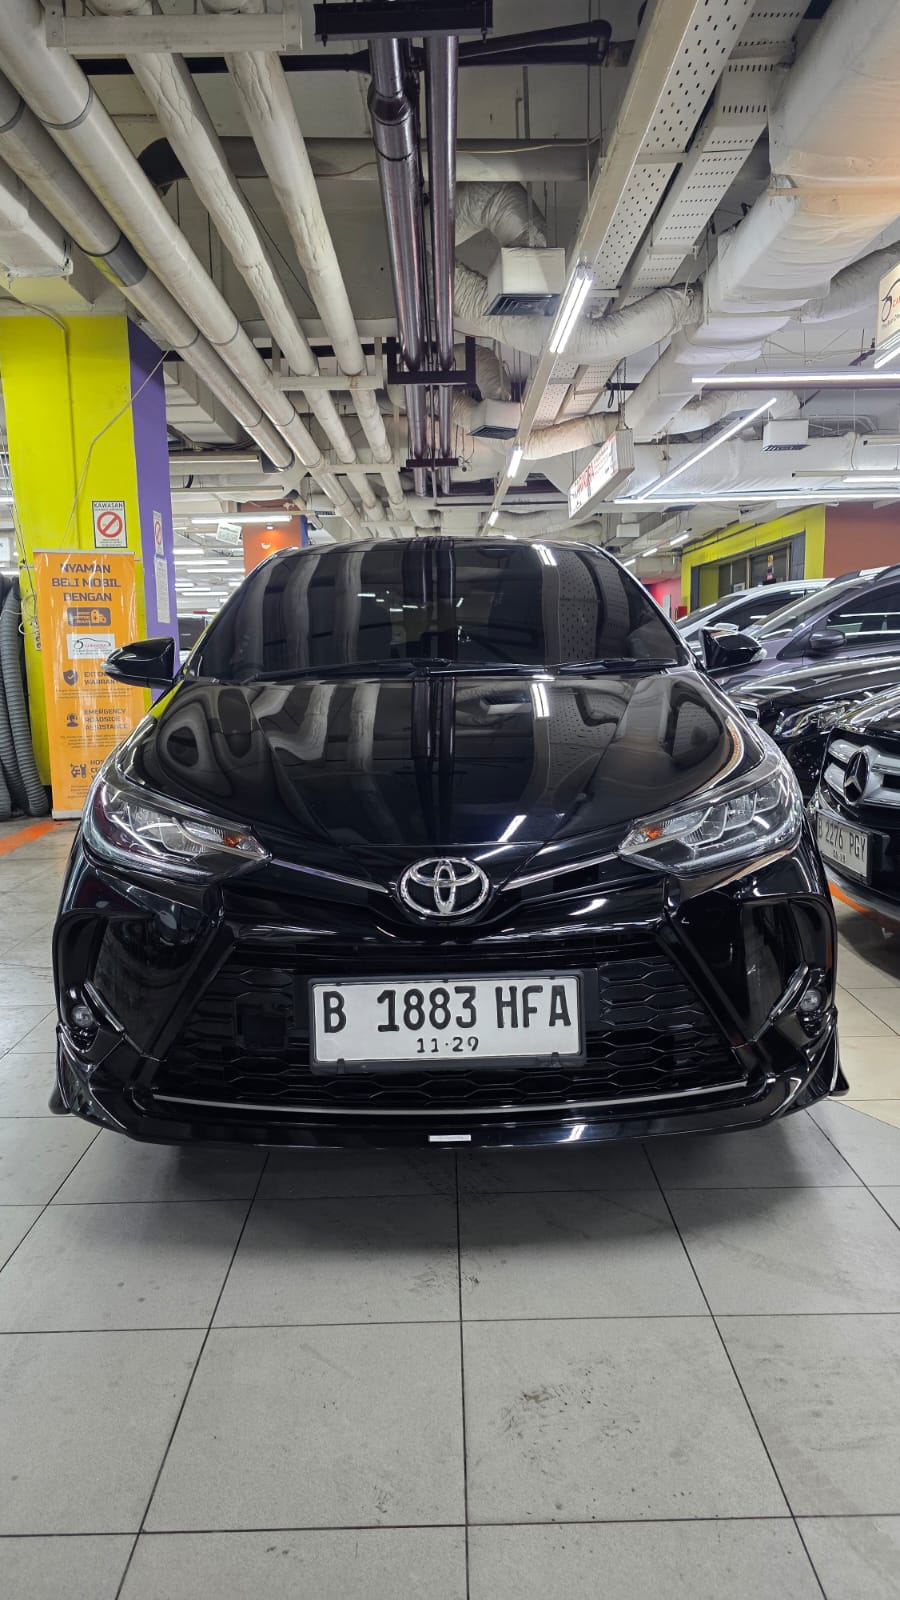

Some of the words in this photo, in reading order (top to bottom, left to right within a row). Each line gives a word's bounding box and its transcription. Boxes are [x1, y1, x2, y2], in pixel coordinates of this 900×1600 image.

[60, 563, 111, 573] NYAMAN
[51, 577, 80, 588] BELI
[82, 577, 122, 588] MOBIL
[63, 592, 113, 602] DENGAN
[825, 822, 843, 849] 2276
[850, 832, 866, 861] PGY
[322, 990, 347, 1034] B
[376, 985, 478, 1033] 1883
[494, 984, 572, 1029] HFA
